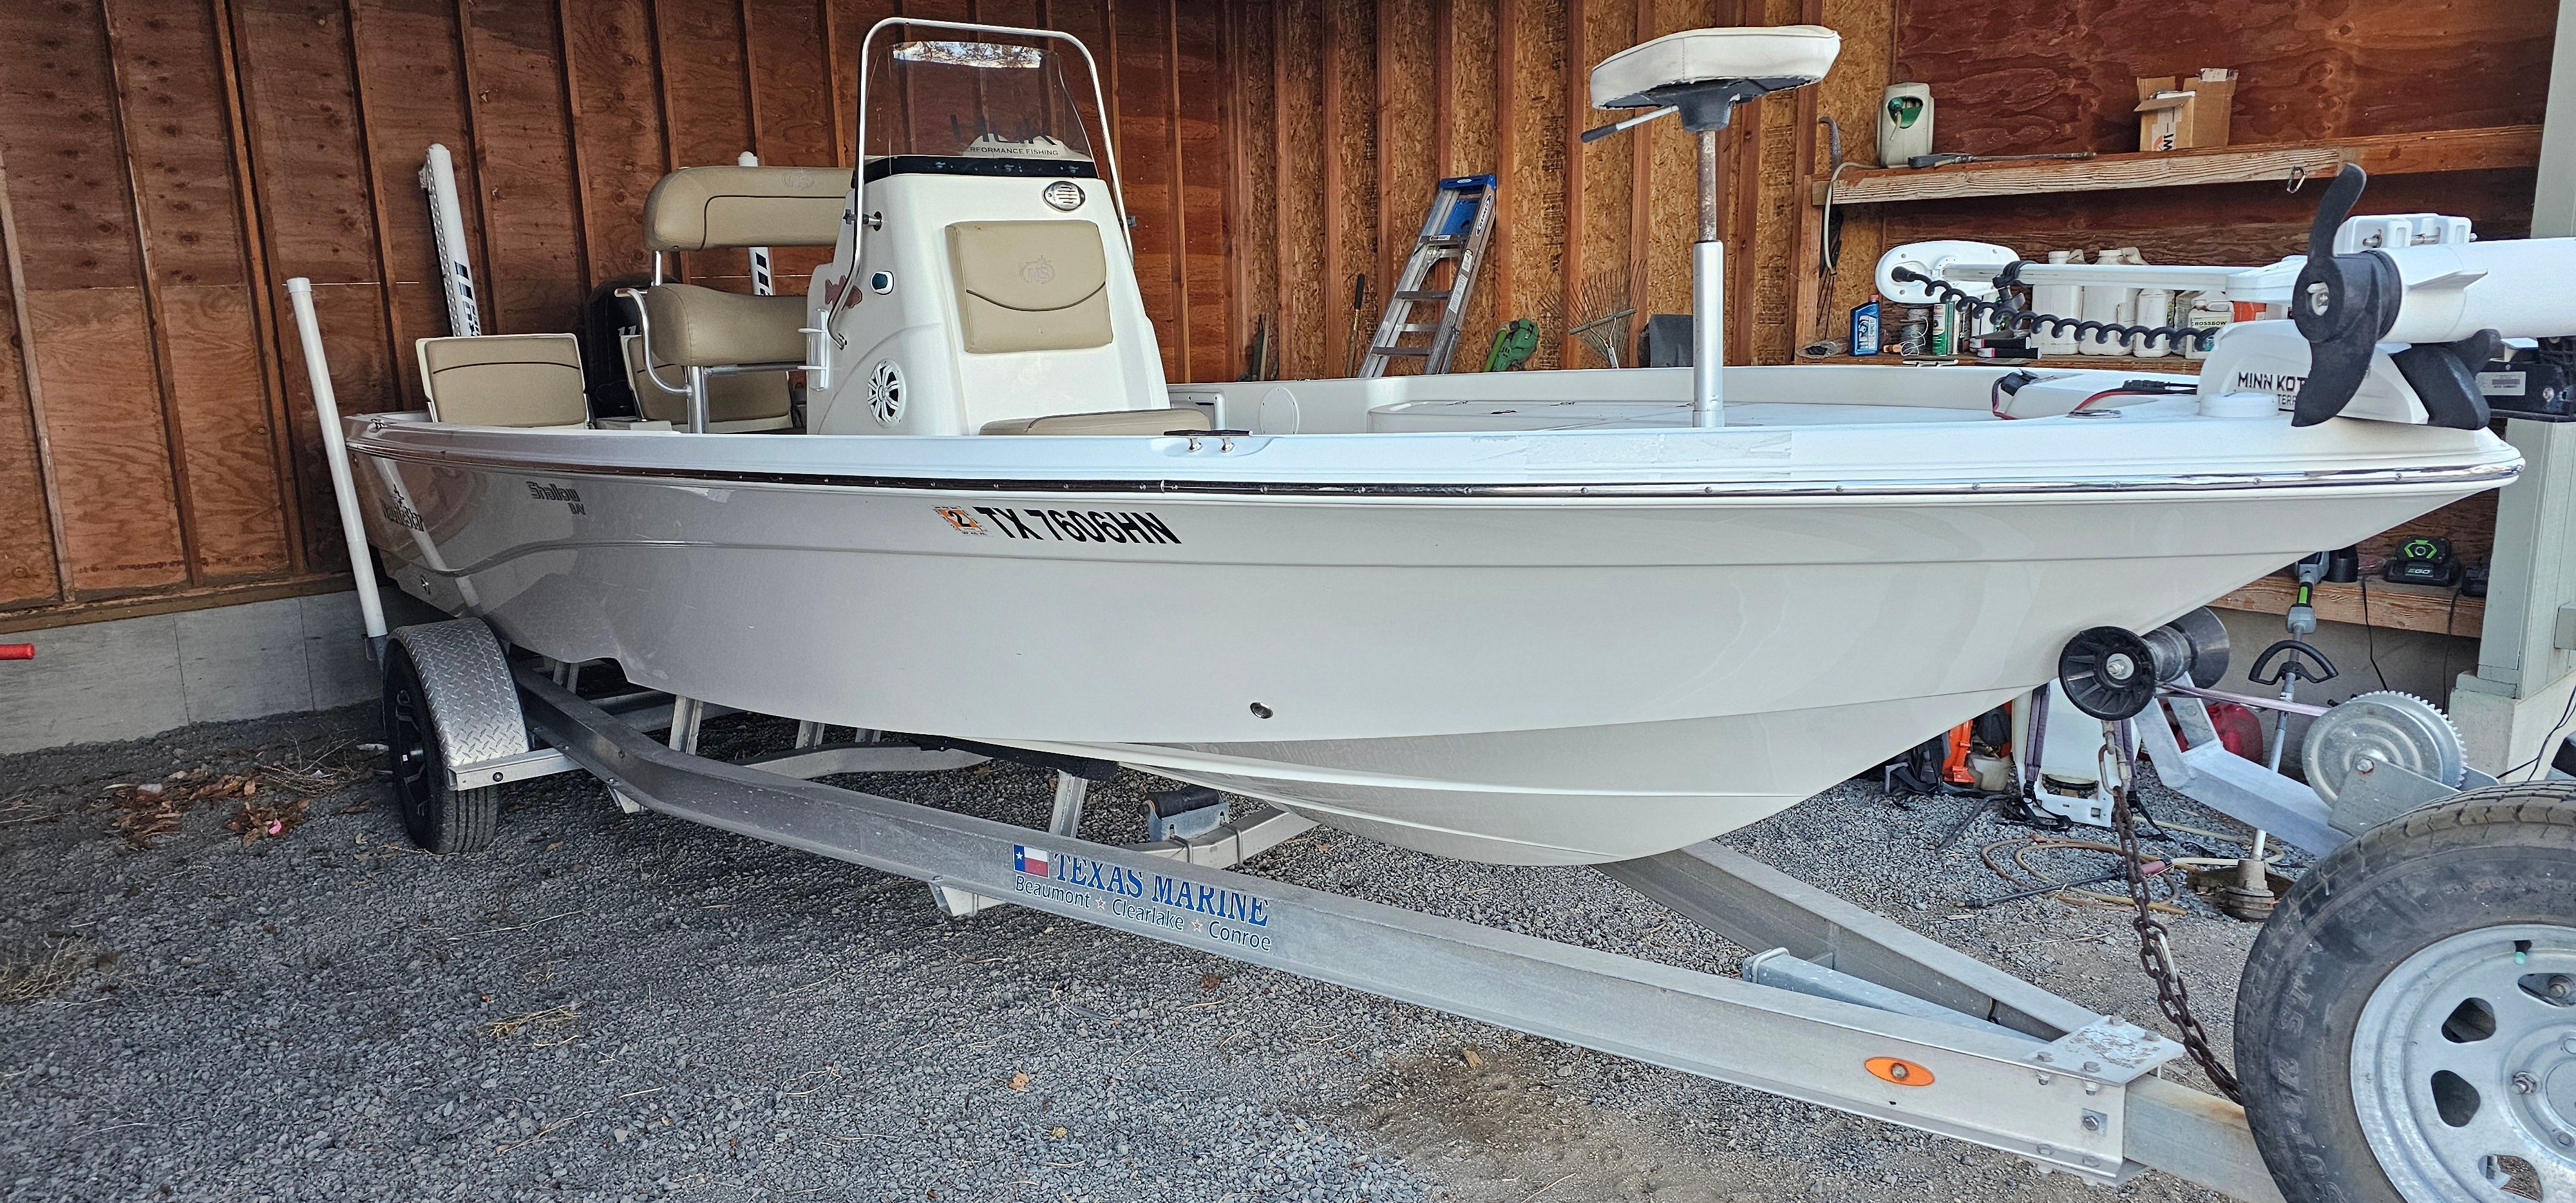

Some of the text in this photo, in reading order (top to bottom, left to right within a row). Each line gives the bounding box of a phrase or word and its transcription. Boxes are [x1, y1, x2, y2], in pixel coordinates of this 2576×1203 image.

[2237, 371, 2308, 392] MINN KOT
[526, 481, 580, 502] Shallow
[567, 502, 586, 515] BAY
[971, 506, 1182, 544] TX 7606HN
[1053, 853, 1270, 927] TEXAS MARINE
[1014, 875, 1273, 952] Beaumont Clearlake Conroe
